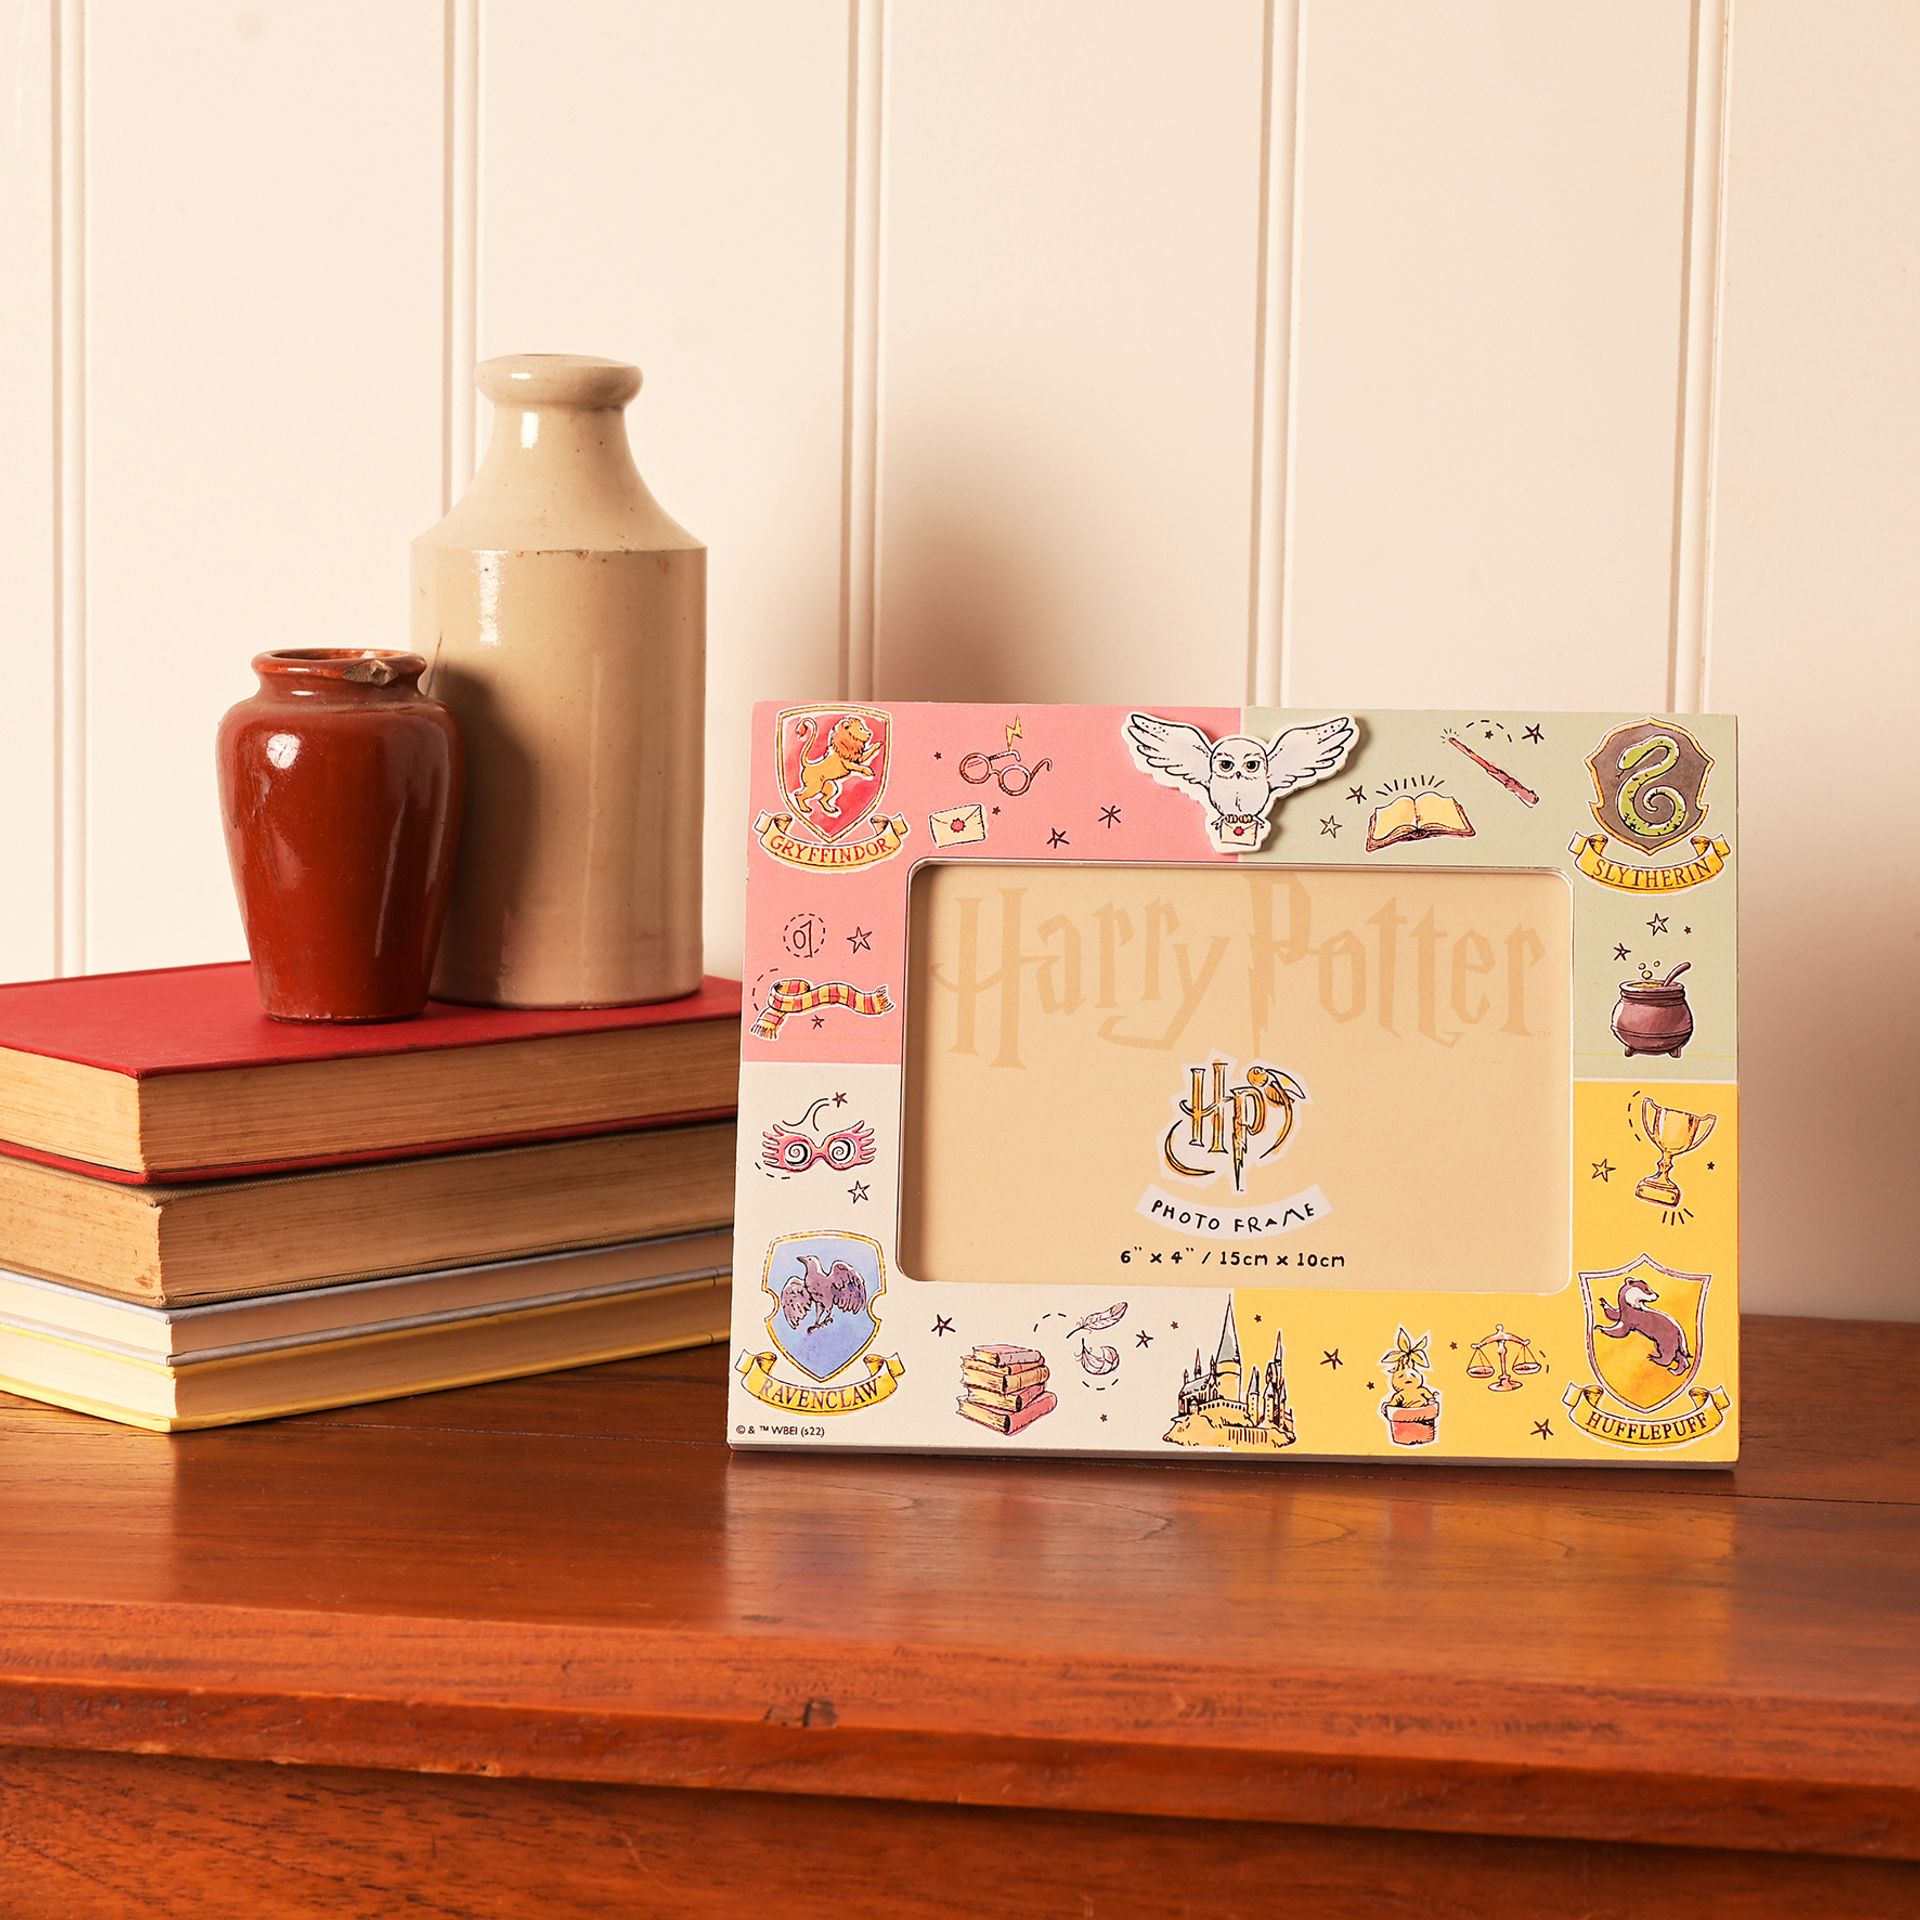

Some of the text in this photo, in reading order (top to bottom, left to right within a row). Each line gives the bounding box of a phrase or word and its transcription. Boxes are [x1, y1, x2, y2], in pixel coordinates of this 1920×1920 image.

[769, 834, 894, 864] GRYFFINDOR
[1592, 857, 1713, 888] SLYTHERIN
[930, 887, 1231, 1070] Harry
[1178, 1062, 1268, 1192] HP
[1151, 1199, 1315, 1233] PHOTO FRAME
[1150, 1252, 1163, 1264] x
[1201, 1251, 1212, 1265] /
[1219, 1251, 1268, 1266] 15cm
[1276, 1254, 1289, 1266] x
[1297, 1252, 1345, 1267] 10cm
[758, 1378, 879, 1410] RAVENCLAW
[747, 1425, 756, 1435] &
[771, 1425, 798, 1436] WBEI
[800, 1426, 826, 1438] (s22)
[1585, 1410, 1707, 1441] HUFFLEPUFF
